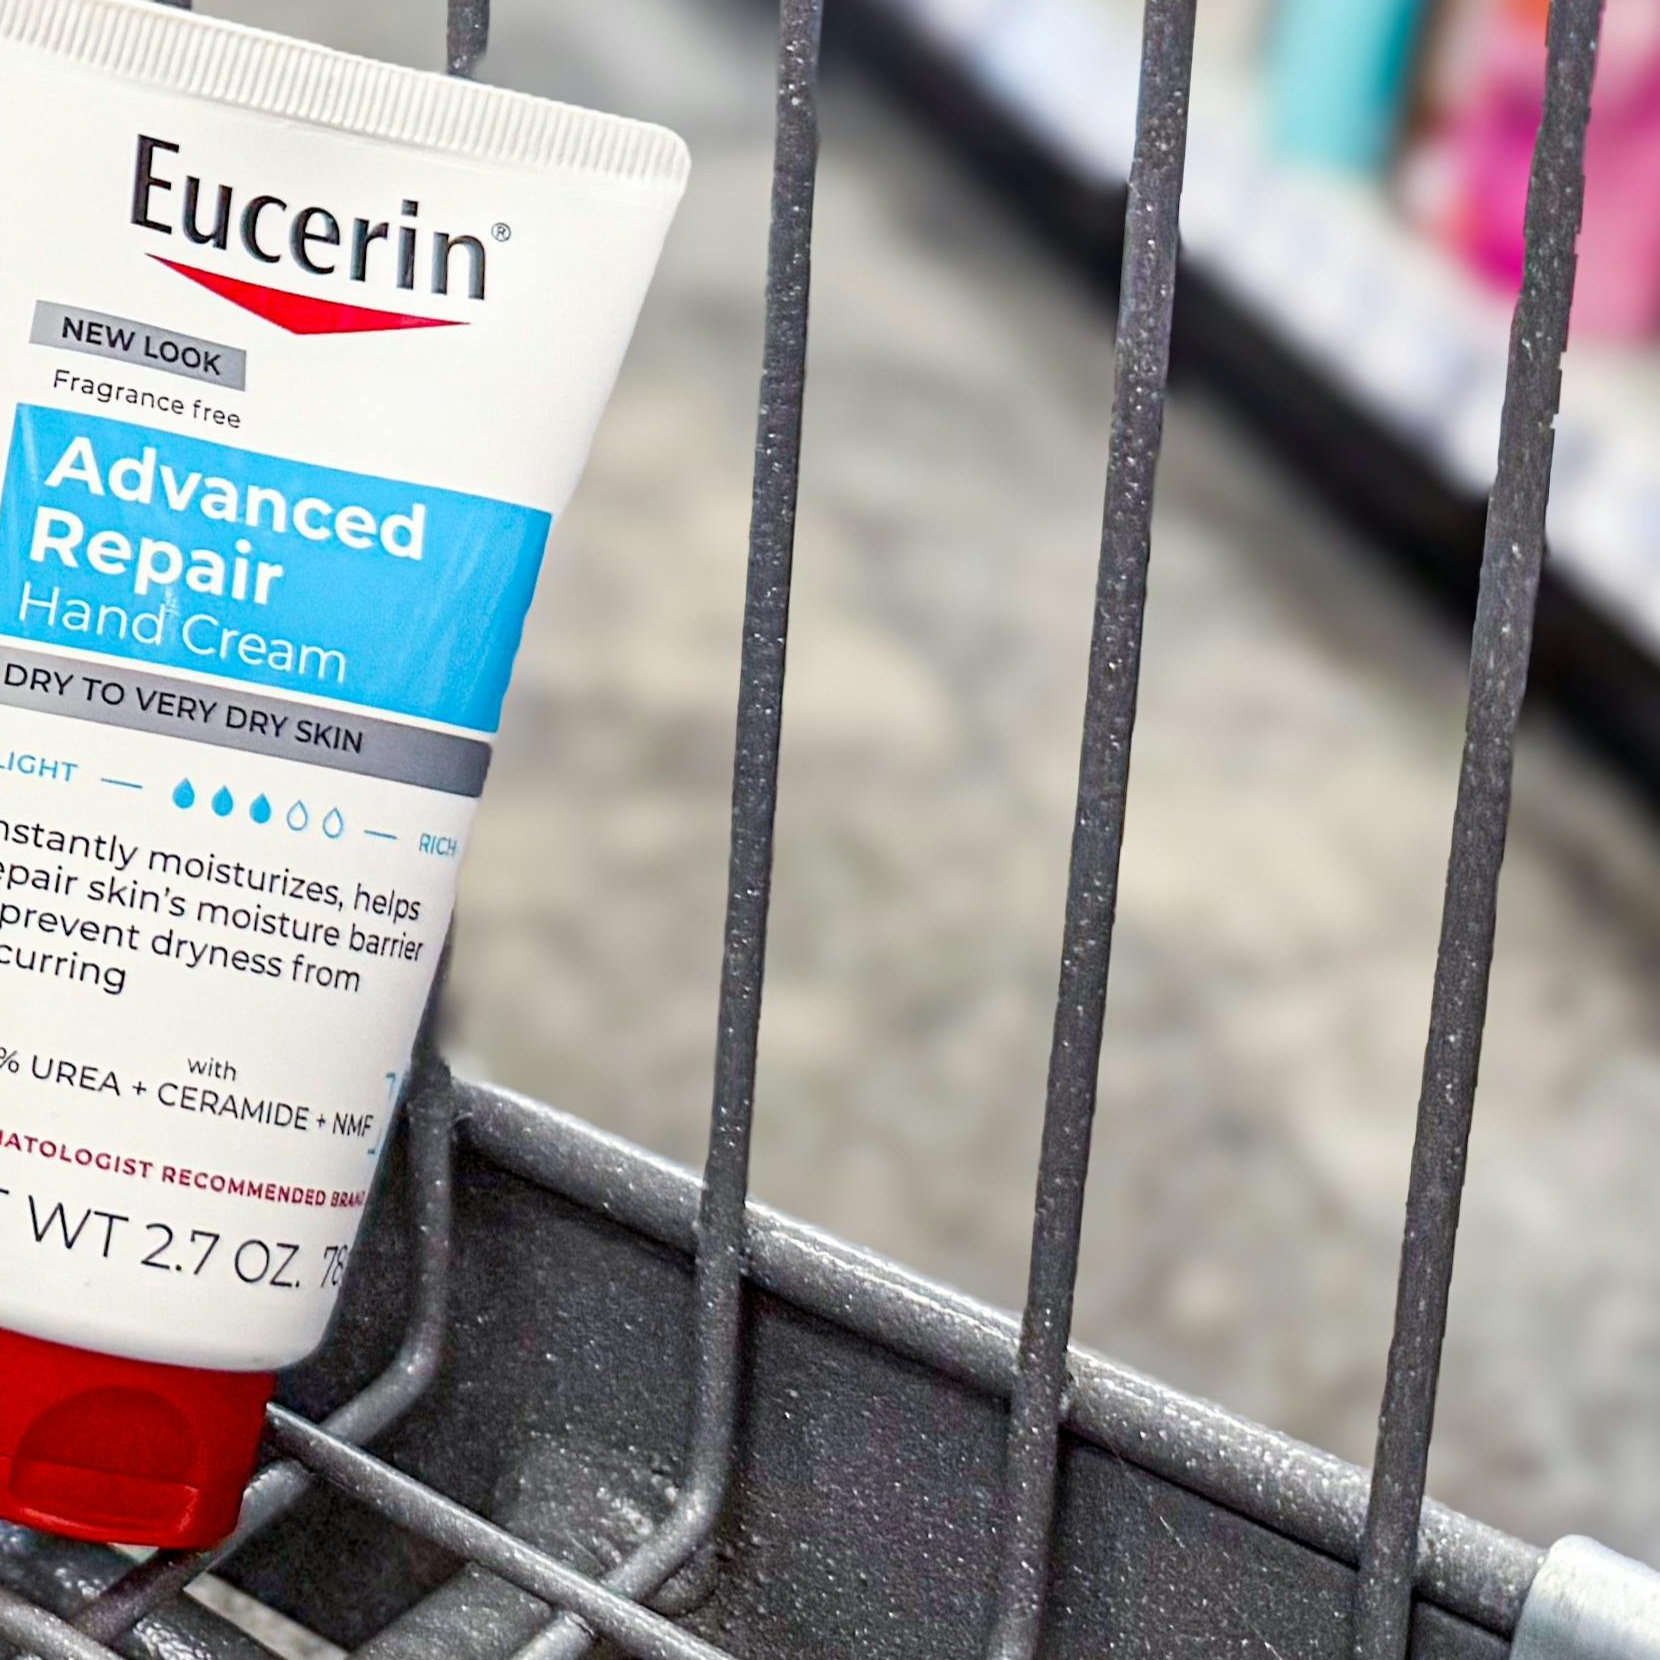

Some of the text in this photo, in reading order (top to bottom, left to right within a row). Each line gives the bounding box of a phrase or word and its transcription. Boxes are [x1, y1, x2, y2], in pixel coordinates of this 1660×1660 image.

[61, 316, 221, 375] NEW LOOK
[54, 369, 241, 429] Fragrance free
[44, 436, 426, 561] Advanced
[29, 506, 284, 604] Repair
[18, 581, 346, 684] Hand Cream
[4, 664, 364, 754] DRY TO VERY DRY SKIN
[418, 833, 457, 856] RICH
[148, 847, 344, 912] moisturizes,
[352, 883, 422, 924] helps
[151, 928, 283, 978] dryness
[292, 955, 362, 993] from
[197, 897, 340, 948] moisture
[348, 924, 424, 963] barrier
[31, 1055, 122, 1096] UREA
[132, 1081, 147, 1096] +
[158, 1082, 309, 1131] CERAMIDE
[316, 1113, 327, 1129] +
[332, 1111, 374, 1138] NMF
[187, 1057, 237, 1081] with
[160, 1165, 326, 1207] RECOMMENDED
[28, 1194, 129, 1258] WT
[141, 1223, 220, 1276] 2.7
[234, 1239, 301, 1289] OZ.
